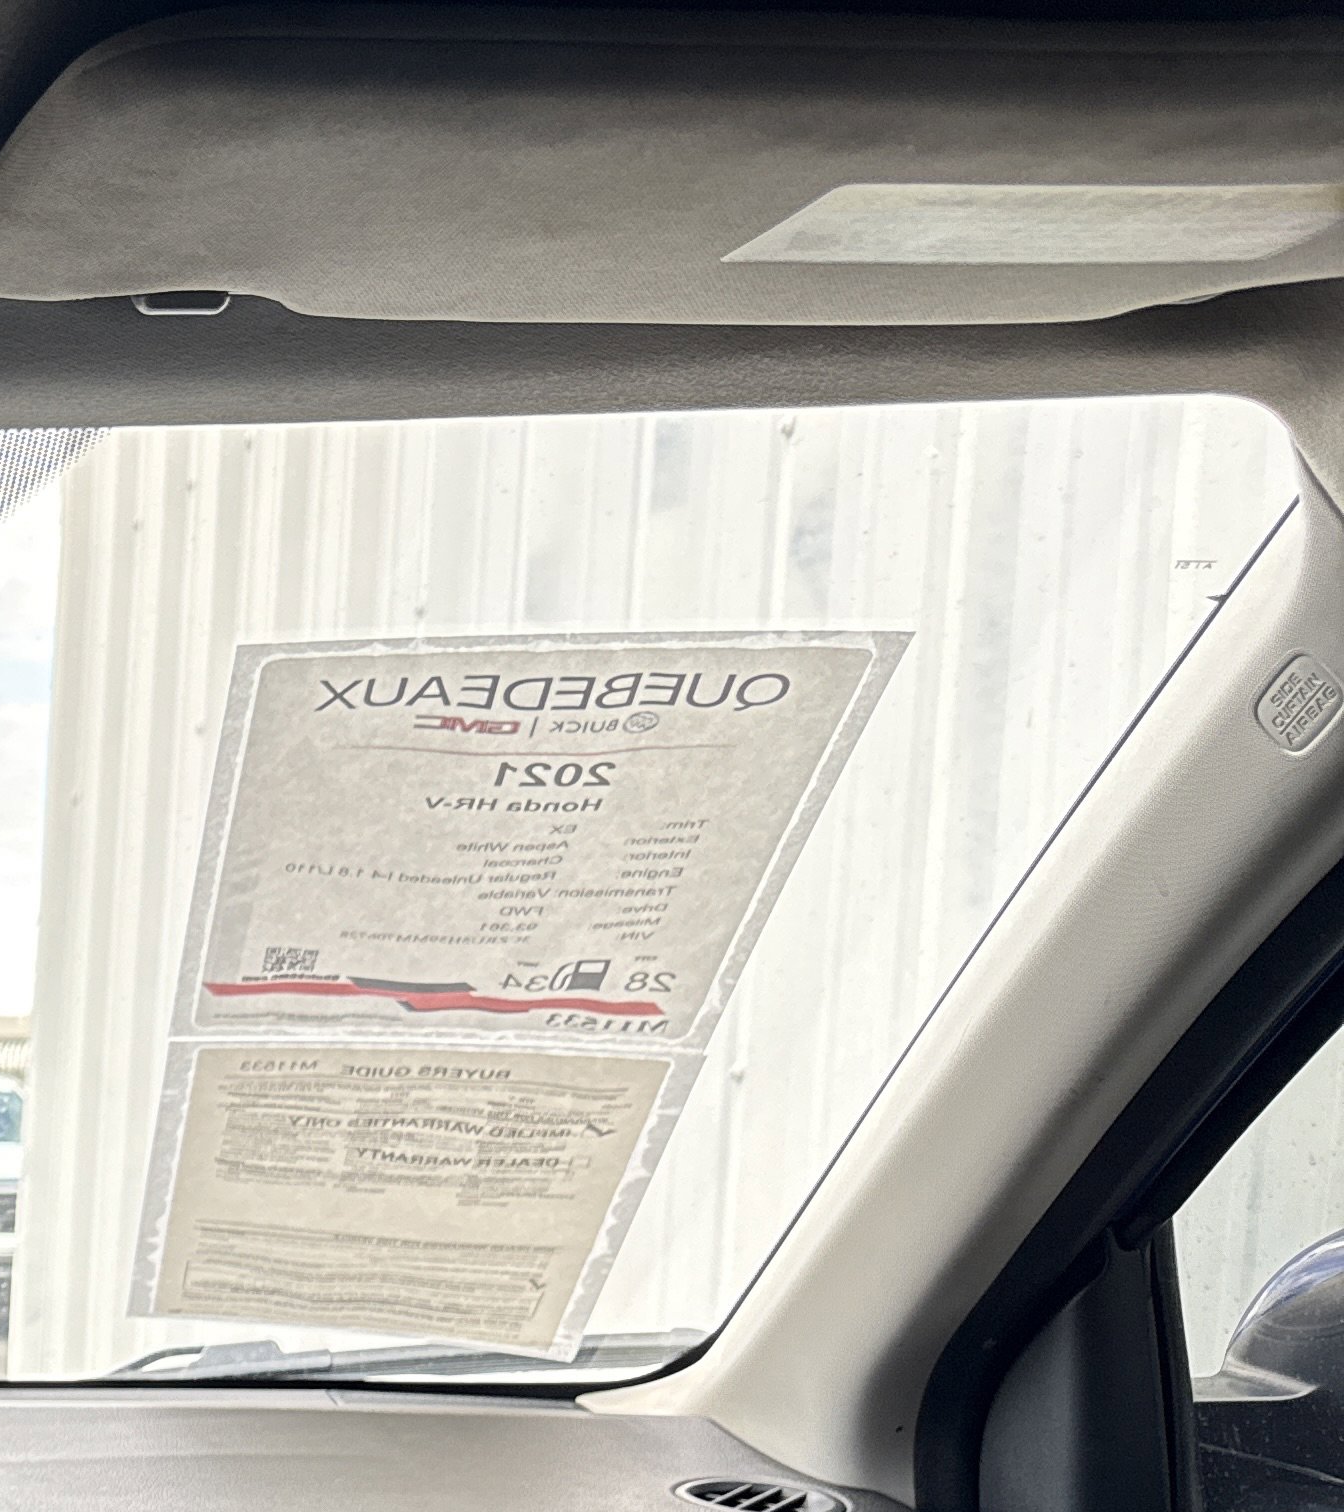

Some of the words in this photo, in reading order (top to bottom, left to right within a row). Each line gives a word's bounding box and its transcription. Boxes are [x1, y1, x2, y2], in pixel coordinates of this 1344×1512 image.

[1270, 671, 1302, 708] SIDE
[1271, 672, 1320, 728] CURTAIN
[1285, 685, 1337, 746] AIRBAG
